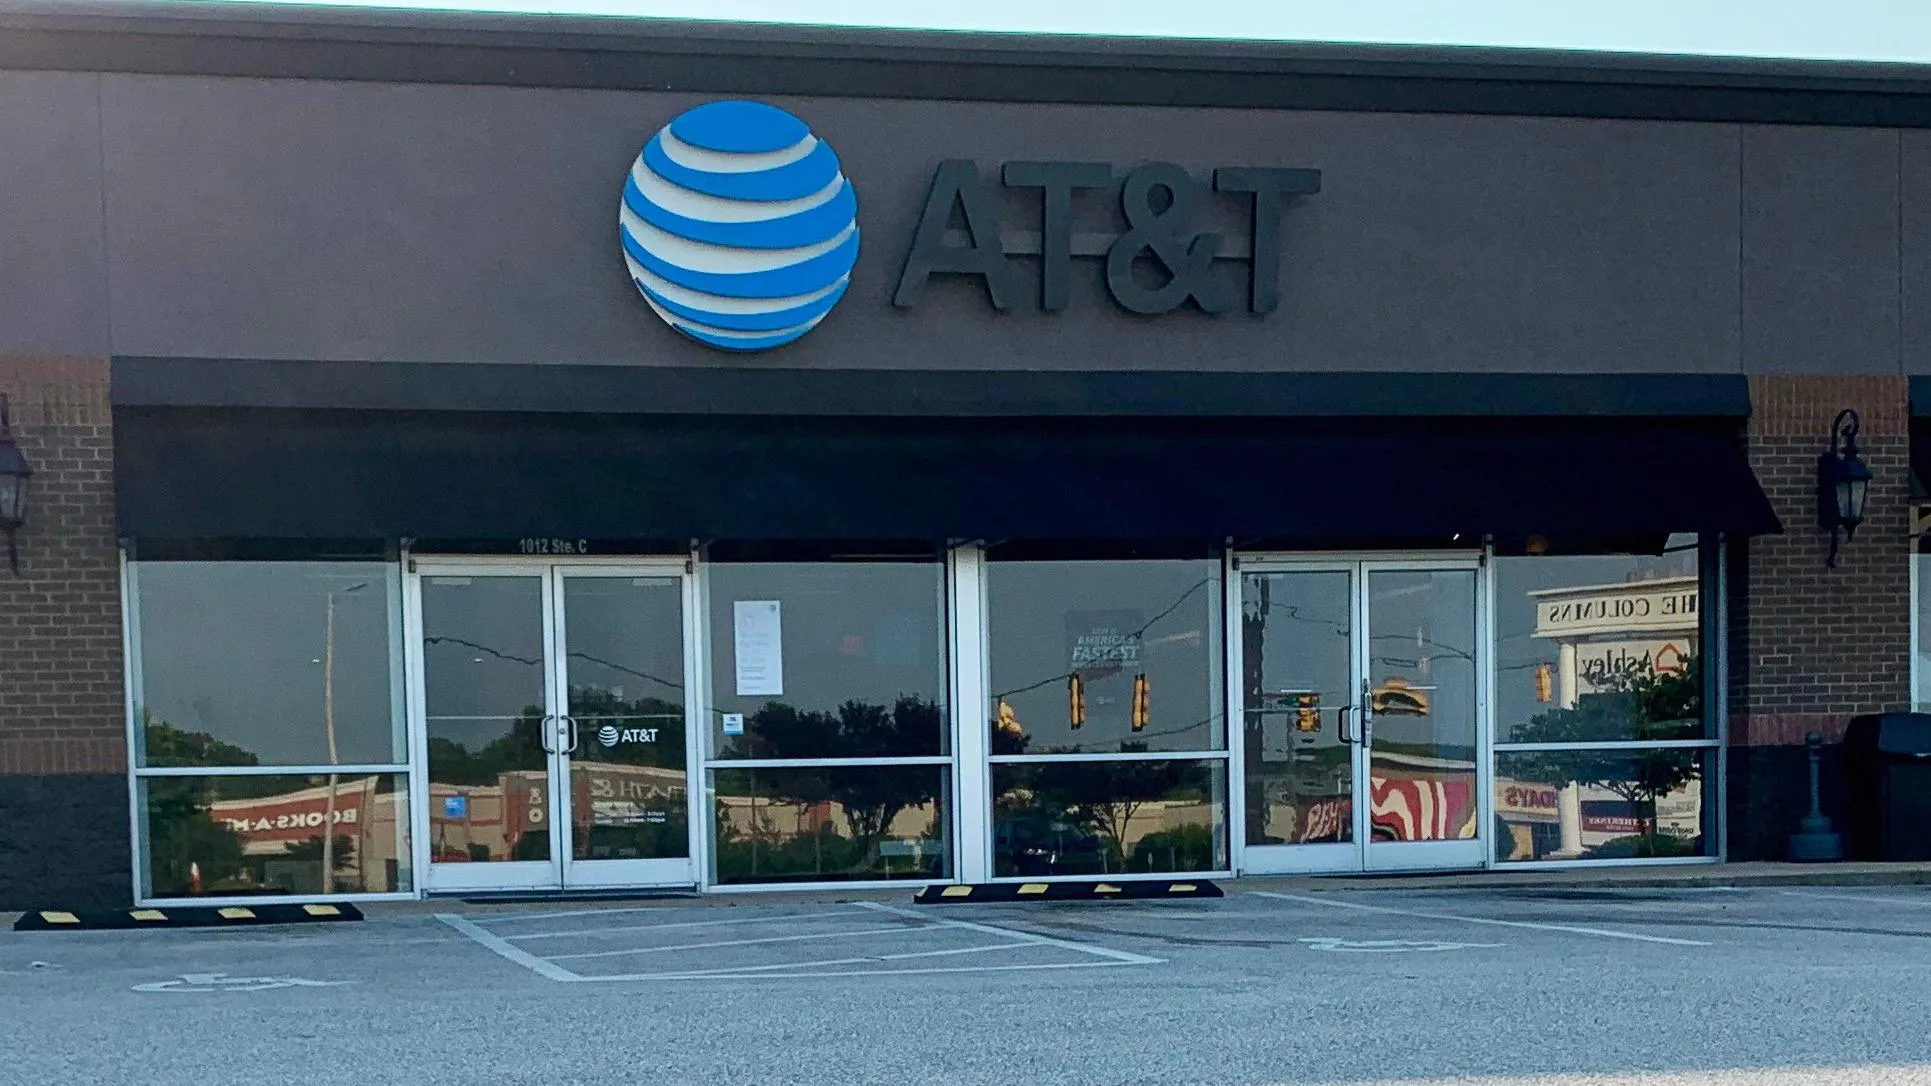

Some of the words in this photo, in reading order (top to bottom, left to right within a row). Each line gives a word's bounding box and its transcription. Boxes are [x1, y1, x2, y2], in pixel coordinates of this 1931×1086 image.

[891, 158, 1322, 314] AT&T
[519, 538, 548, 553] 1012
[551, 539, 576, 553] Ste.
[578, 539, 587, 553] C
[620, 728, 659, 743] AT&T
